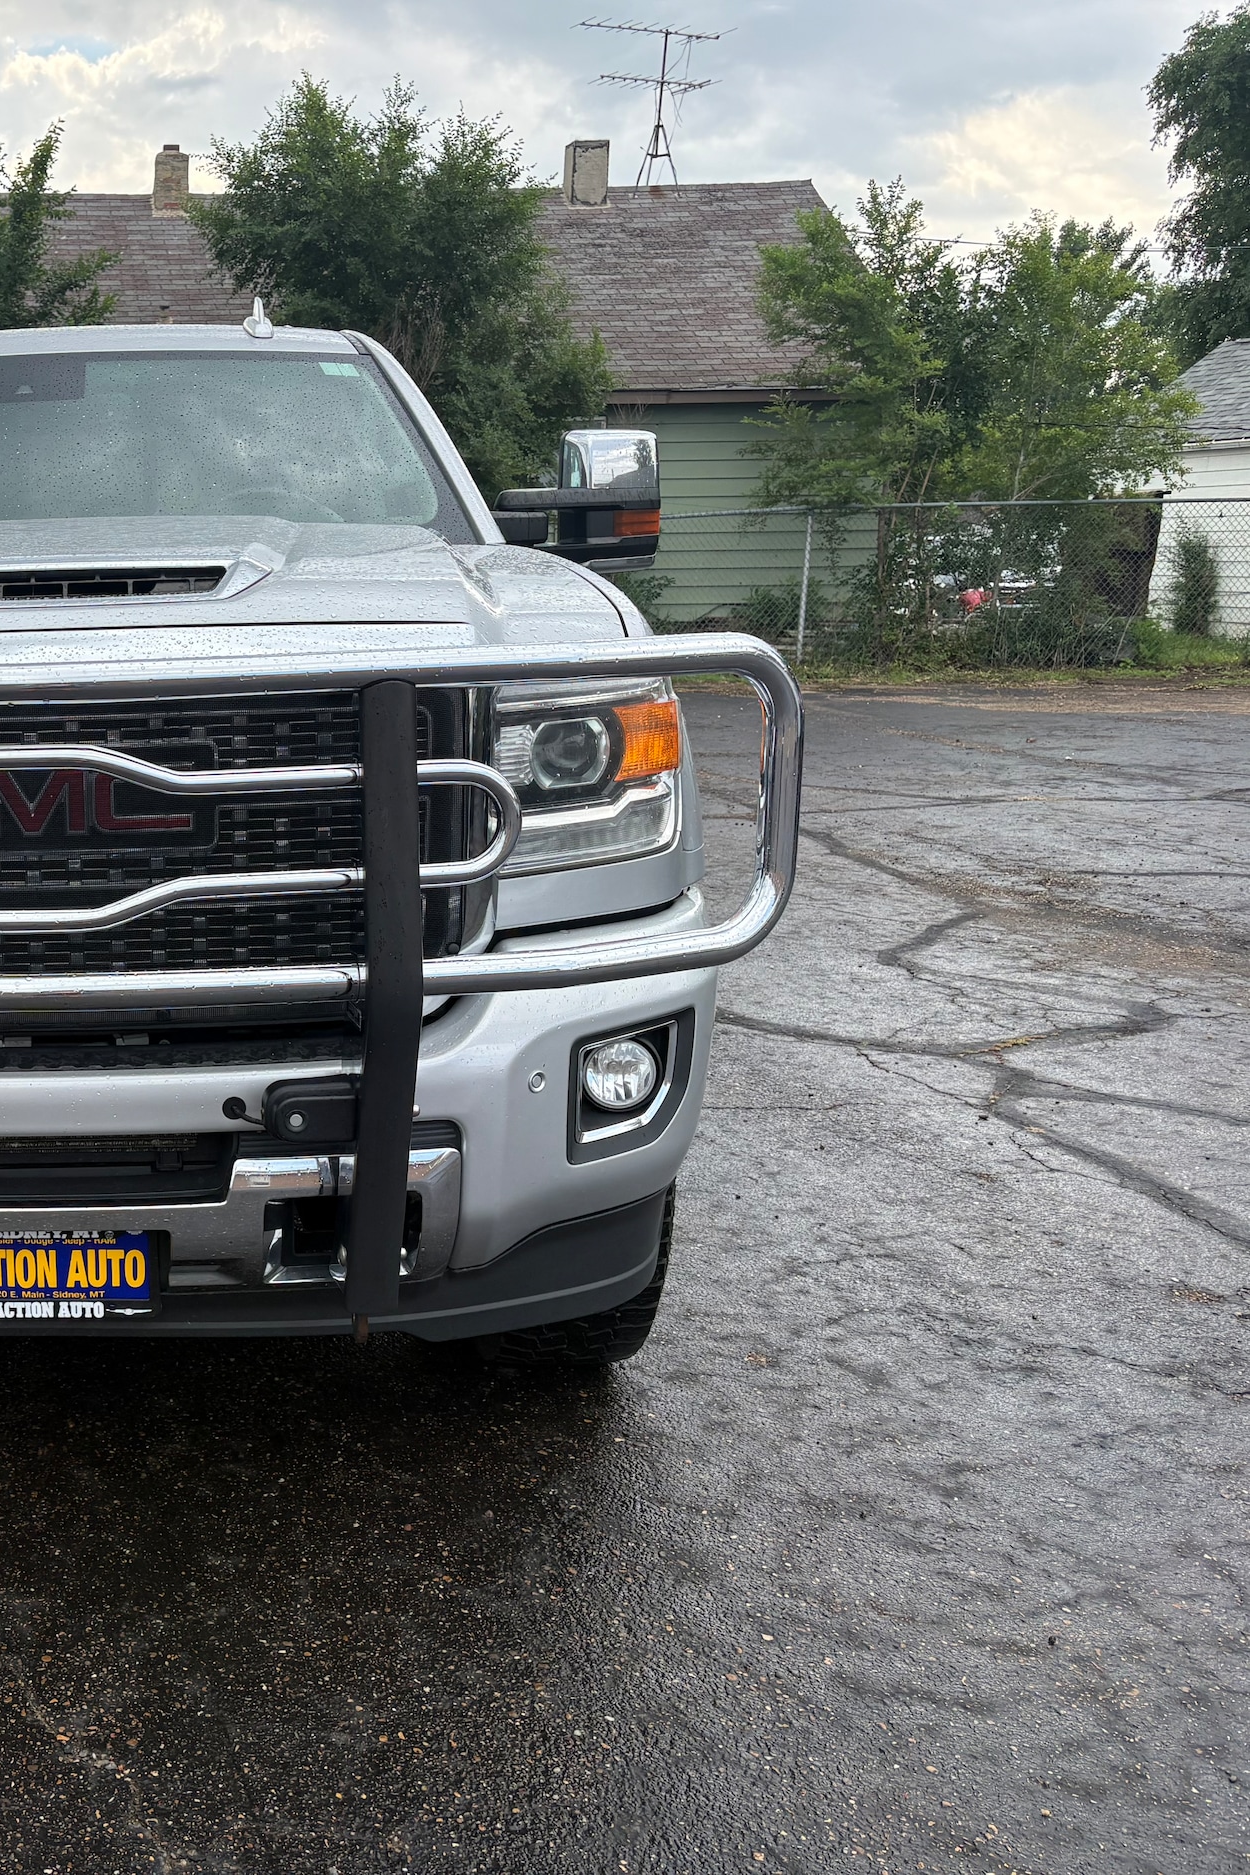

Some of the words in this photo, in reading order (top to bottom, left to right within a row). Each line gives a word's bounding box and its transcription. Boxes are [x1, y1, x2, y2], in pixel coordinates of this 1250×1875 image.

[66, 1249, 146, 1288] AUTO
[10, 1290, 19, 1298] E.
[21, 1291, 45, 1299] Main
[52, 1291, 87, 1299] Sidney,
[89, 1290, 105, 1298] MT
[57, 1301, 105, 1319] AUTO
